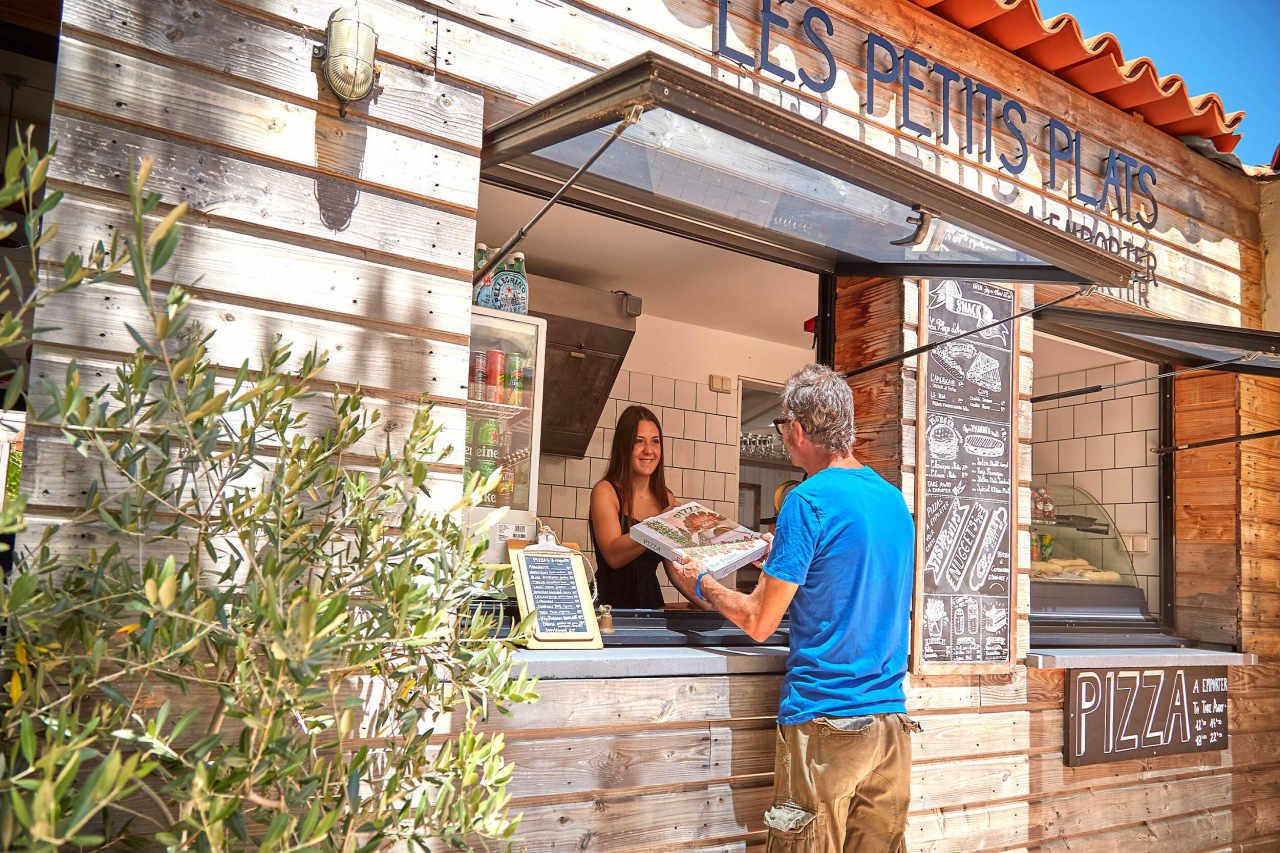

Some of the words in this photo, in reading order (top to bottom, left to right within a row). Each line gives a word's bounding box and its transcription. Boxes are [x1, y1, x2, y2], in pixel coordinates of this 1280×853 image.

[718, 0, 837, 93] LES
[866, 32, 1028, 175] PETITS
[1049, 118, 1160, 230] PLATS
[956, 300, 982, 319] SNACK
[949, 520, 977, 580] NUGGETS
[1075, 669, 1191, 757] PIZZA
[1192, 679, 1200, 694] A
